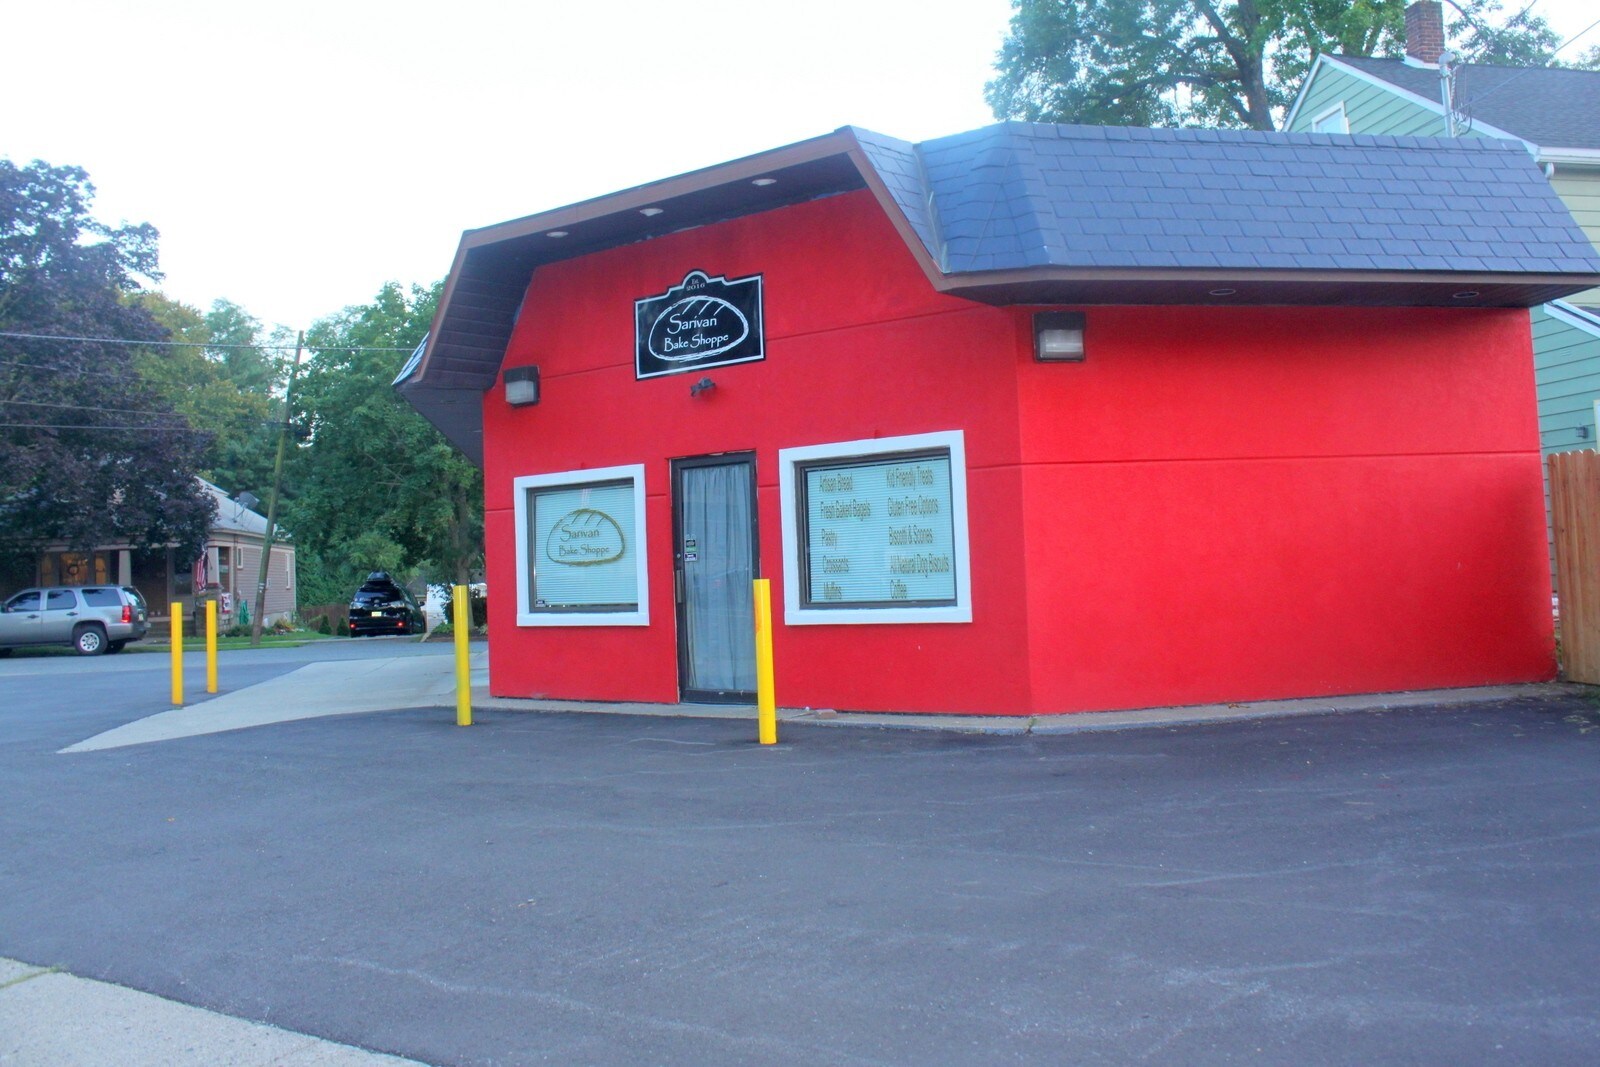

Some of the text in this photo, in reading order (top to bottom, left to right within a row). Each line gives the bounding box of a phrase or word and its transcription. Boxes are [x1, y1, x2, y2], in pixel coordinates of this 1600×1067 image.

[686, 283, 705, 291] 2016
[667, 313, 717, 334] Sarivan
[664, 334, 729, 352] Bake Shoppe
[838, 472, 853, 490] Bread
[896, 467, 915, 491] Friendly
[917, 466, 933, 485] Treats
[821, 498, 871, 521] Fresh Baked Bagels
[888, 495, 938, 518] Gluten Free Options
[560, 524, 600, 542] Sarivan
[913, 524, 933, 544] Scones
[559, 544, 610, 557] Bake Shoppe
[917, 554, 928, 578] Dog
[929, 553, 949, 573] Biscuits
[890, 579, 907, 600] Coffee
